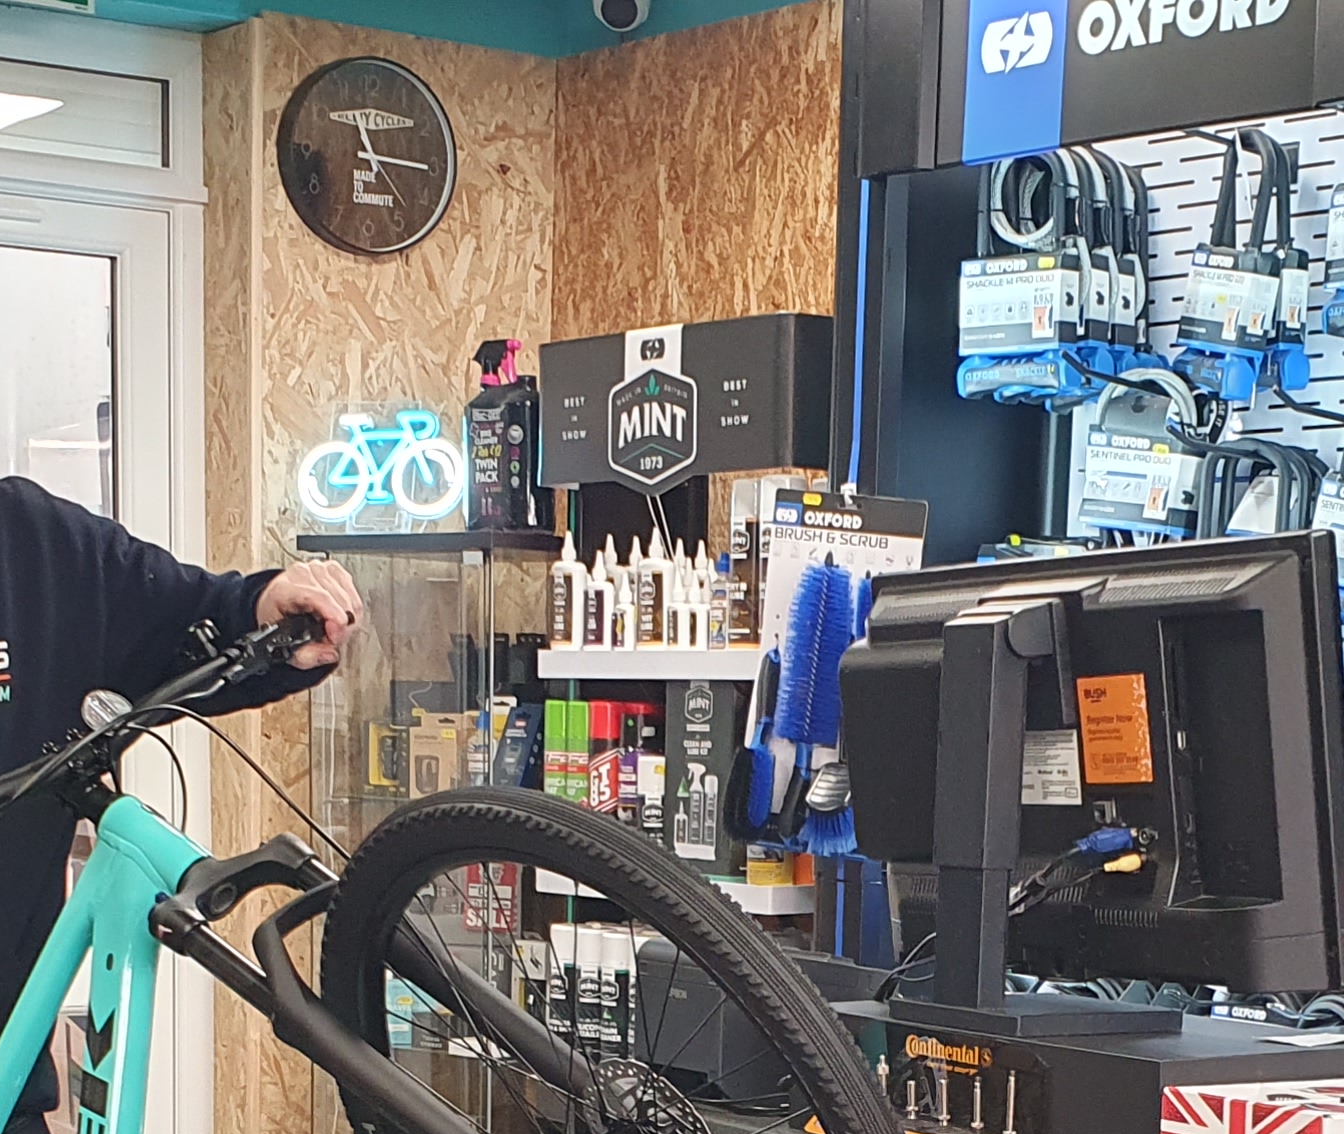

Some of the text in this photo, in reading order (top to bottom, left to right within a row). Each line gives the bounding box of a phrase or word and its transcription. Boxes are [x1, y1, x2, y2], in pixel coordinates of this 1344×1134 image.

[362, 75, 380, 97] 12
[420, 119, 431, 137] 2
[308, 173, 321, 195] 8
[353, 169, 377, 183] MADE
[353, 181, 364, 193] TO
[353, 192, 394, 208] COMMUTE
[363, 218, 375, 237] 6
[393, 211, 405, 231] 5
[986, 259, 1028, 275] OXFORD
[723, 379, 747, 392] BEST
[563, 396, 585, 408] BEST
[618, 401, 687, 450] MINT
[720, 414, 749, 428] SHOW
[562, 430, 587, 441] SHOW
[475, 458, 498, 471] TWIN
[639, 456, 664, 471] 1973
[475, 471, 499, 483] PACK
[803, 511, 862, 529] OXFORD
[774, 527, 889, 550] BRUSH & SCRUB
[1231, 1006, 1267, 1021] OXFORD
[906, 1034, 979, 1066] Continental
